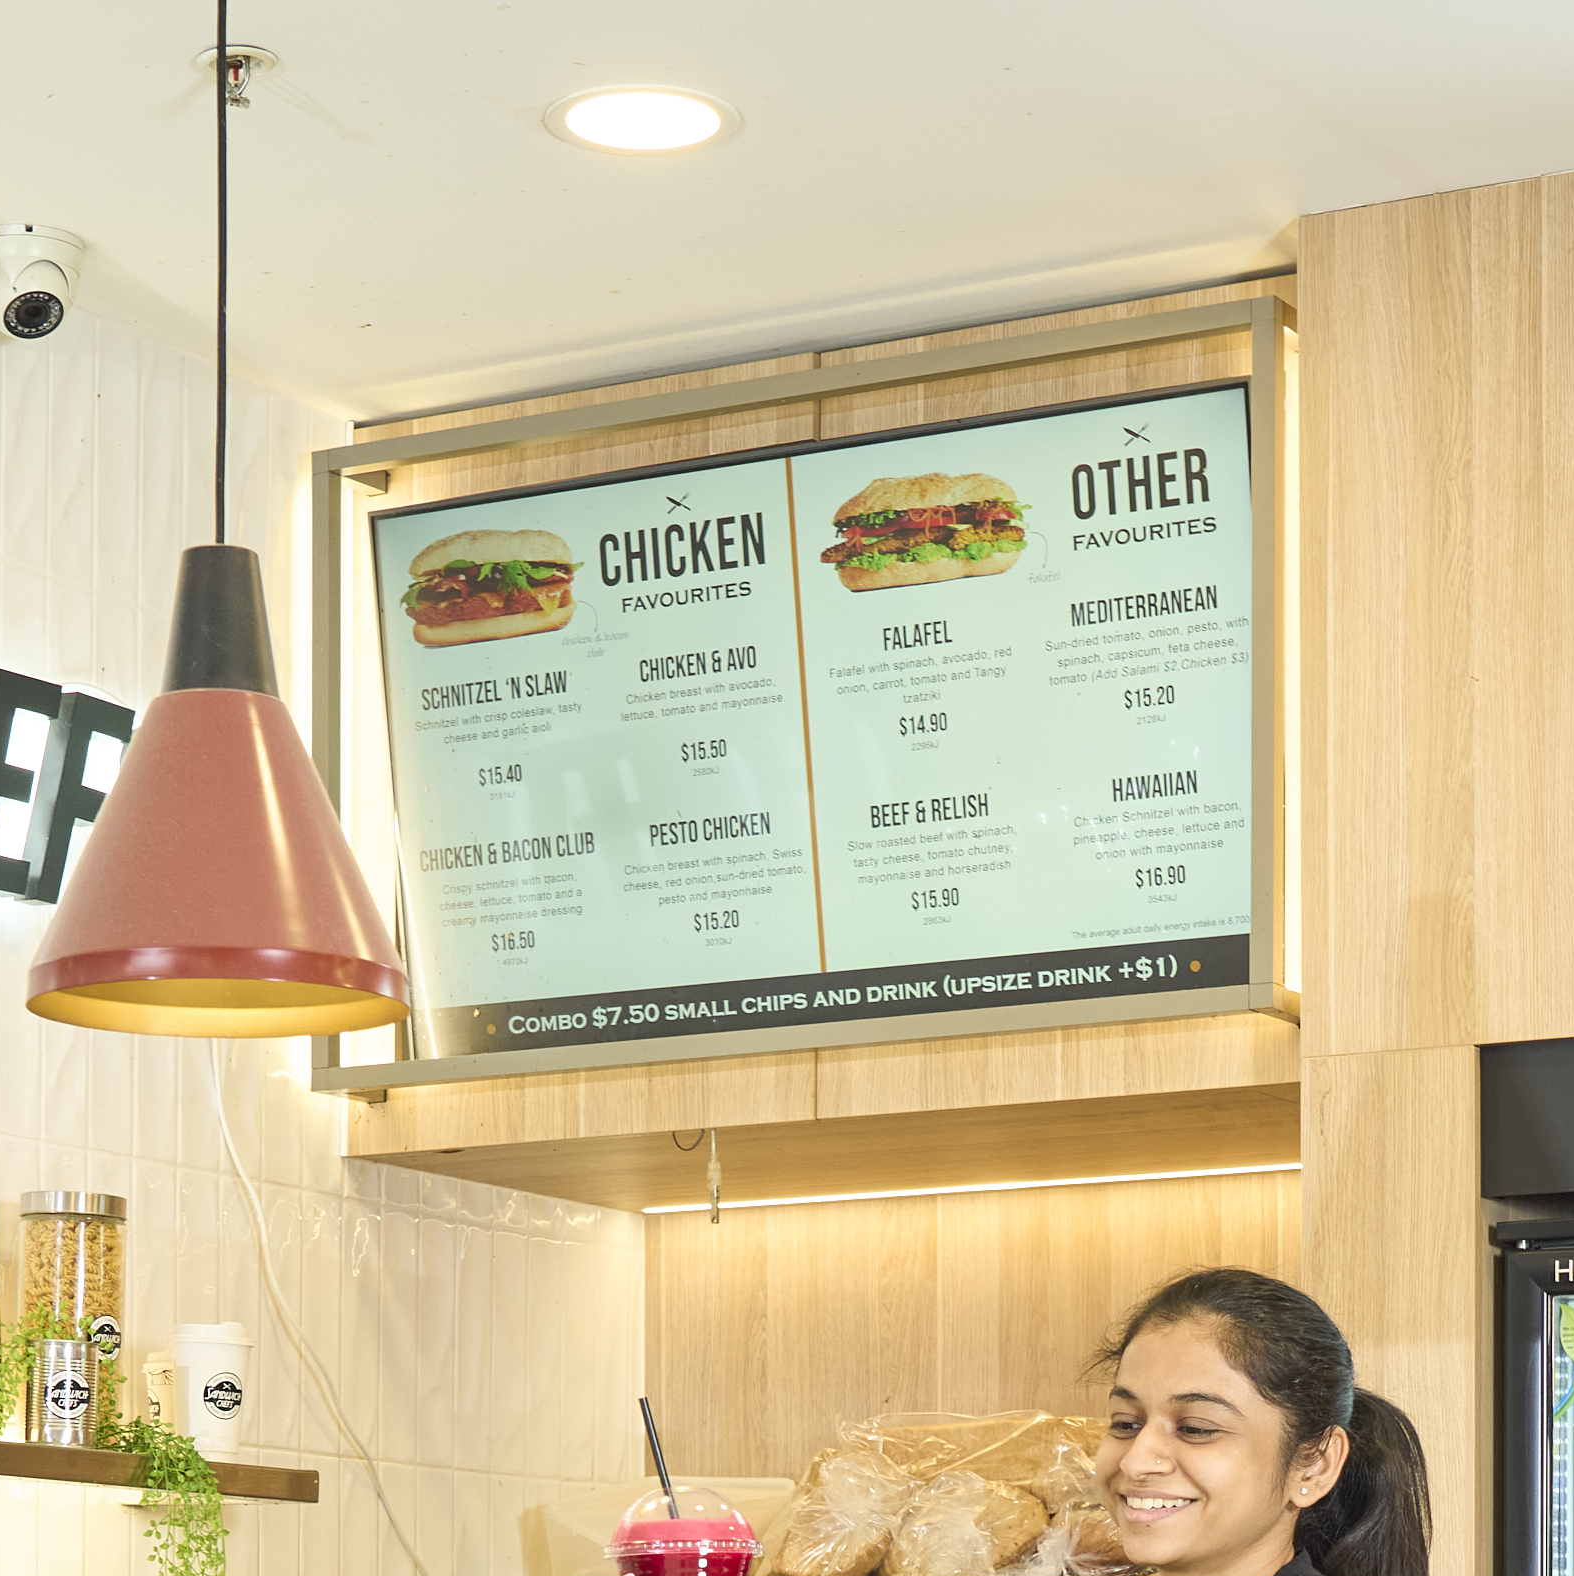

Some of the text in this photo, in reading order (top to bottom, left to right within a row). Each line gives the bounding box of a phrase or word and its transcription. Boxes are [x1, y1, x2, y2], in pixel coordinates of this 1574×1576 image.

[1071, 447, 1211, 520] OTHER
[599, 512, 766, 587] CHICKEN
[1073, 516, 1218, 551] FAVOURITES
[621, 581, 753, 613] FAVOURITES
[1070, 584, 1219, 627] MEDITERRANEAN
[882, 620, 954, 652] FALAFEL
[1045, 616, 1249, 652] Sun-dried tomato, onion, pesto, with
[639, 645, 758, 683] CHICKEN & AVO
[829, 646, 1013, 679] Falafel with spinach, avocado, red
[1049, 672, 1087, 686] tomato
[1091, 667, 1118, 683] (Add
[1121, 663, 1160, 677] Salami
[1230, 652, 1250, 666] $3)
[1057, 637, 1239, 669] spinach, capsicum, feta cheese,
[421, 680, 503, 711] SCHNITZEL
[525, 670, 568, 698] SLAW
[626, 677, 777, 705] Chicken breast with avocado,
[836, 665, 1007, 695] onion, carrot, tomato and Tangy
[620, 693, 783, 723] lettuce, tomato and mayonnaise
[903, 690, 942, 704] tzatziki
[1124, 684, 1176, 710] $15.20
[899, 712, 949, 737] $14.90
[680, 738, 728, 763] $15.50
[478, 763, 523, 787] $15.40
[1112, 769, 1198, 802] HAWAIIAN
[870, 793, 990, 828] BEEF & RELISH
[649, 811, 772, 847] PESTO CHICKEN
[847, 824, 1018, 852] Slow roasted beef with spinach,
[419, 831, 596, 873] CHICKEN & BACON CLUB
[1135, 864, 1187, 890] $16.90
[911, 887, 961, 911] $15.90
[693, 909, 740, 933] $15.20
[491, 930, 536, 953] $16.50
[592, 1003, 661, 1030] $7.50
[664, 999, 738, 1022] SMALL
[740, 992, 809, 1015] CHIPS
[812, 987, 862, 1008] AND
[866, 980, 939, 1004] DRINK
[942, 970, 1033, 999] (UPSIZE
[1037, 965, 1113, 989] DRINK
[1118, 955, 1179, 982] +$1)
[204, 1387, 242, 1401] SANDWICH
[215, 1399, 234, 1409] CHEFS
